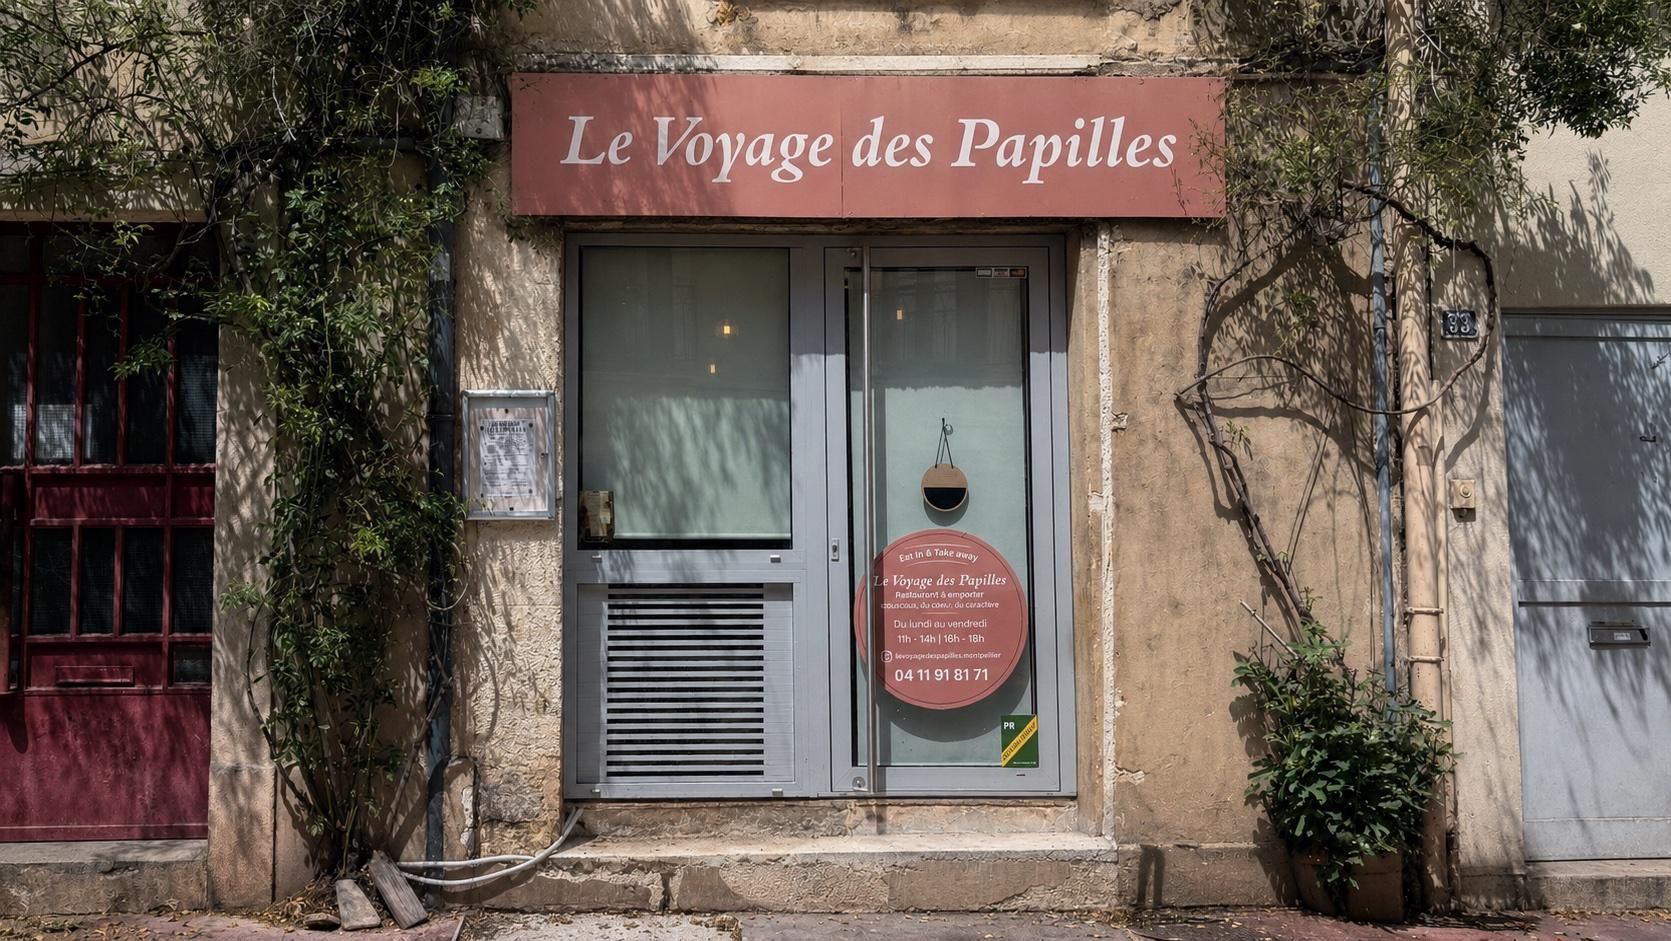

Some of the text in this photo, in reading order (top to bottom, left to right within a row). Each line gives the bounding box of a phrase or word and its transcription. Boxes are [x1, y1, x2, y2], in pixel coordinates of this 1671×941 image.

[560, 115, 1176, 185] Le Voyage des Papilles
[1448, 313, 1470, 333] 33
[899, 554, 914, 563] Eat
[935, 549, 954, 557] Take
[956, 552, 978, 563] away
[873, 574, 1007, 589] Le Voyage des Papilles
[894, 620, 906, 628] Du
[909, 620, 931, 628] lundi
[948, 620, 987, 628] vendredi
[898, 635, 911, 643] 11h
[920, 635, 935, 643] 14h
[895, 669, 988, 681] 04 11 91 81 71
[1003, 722, 1015, 730] PR
